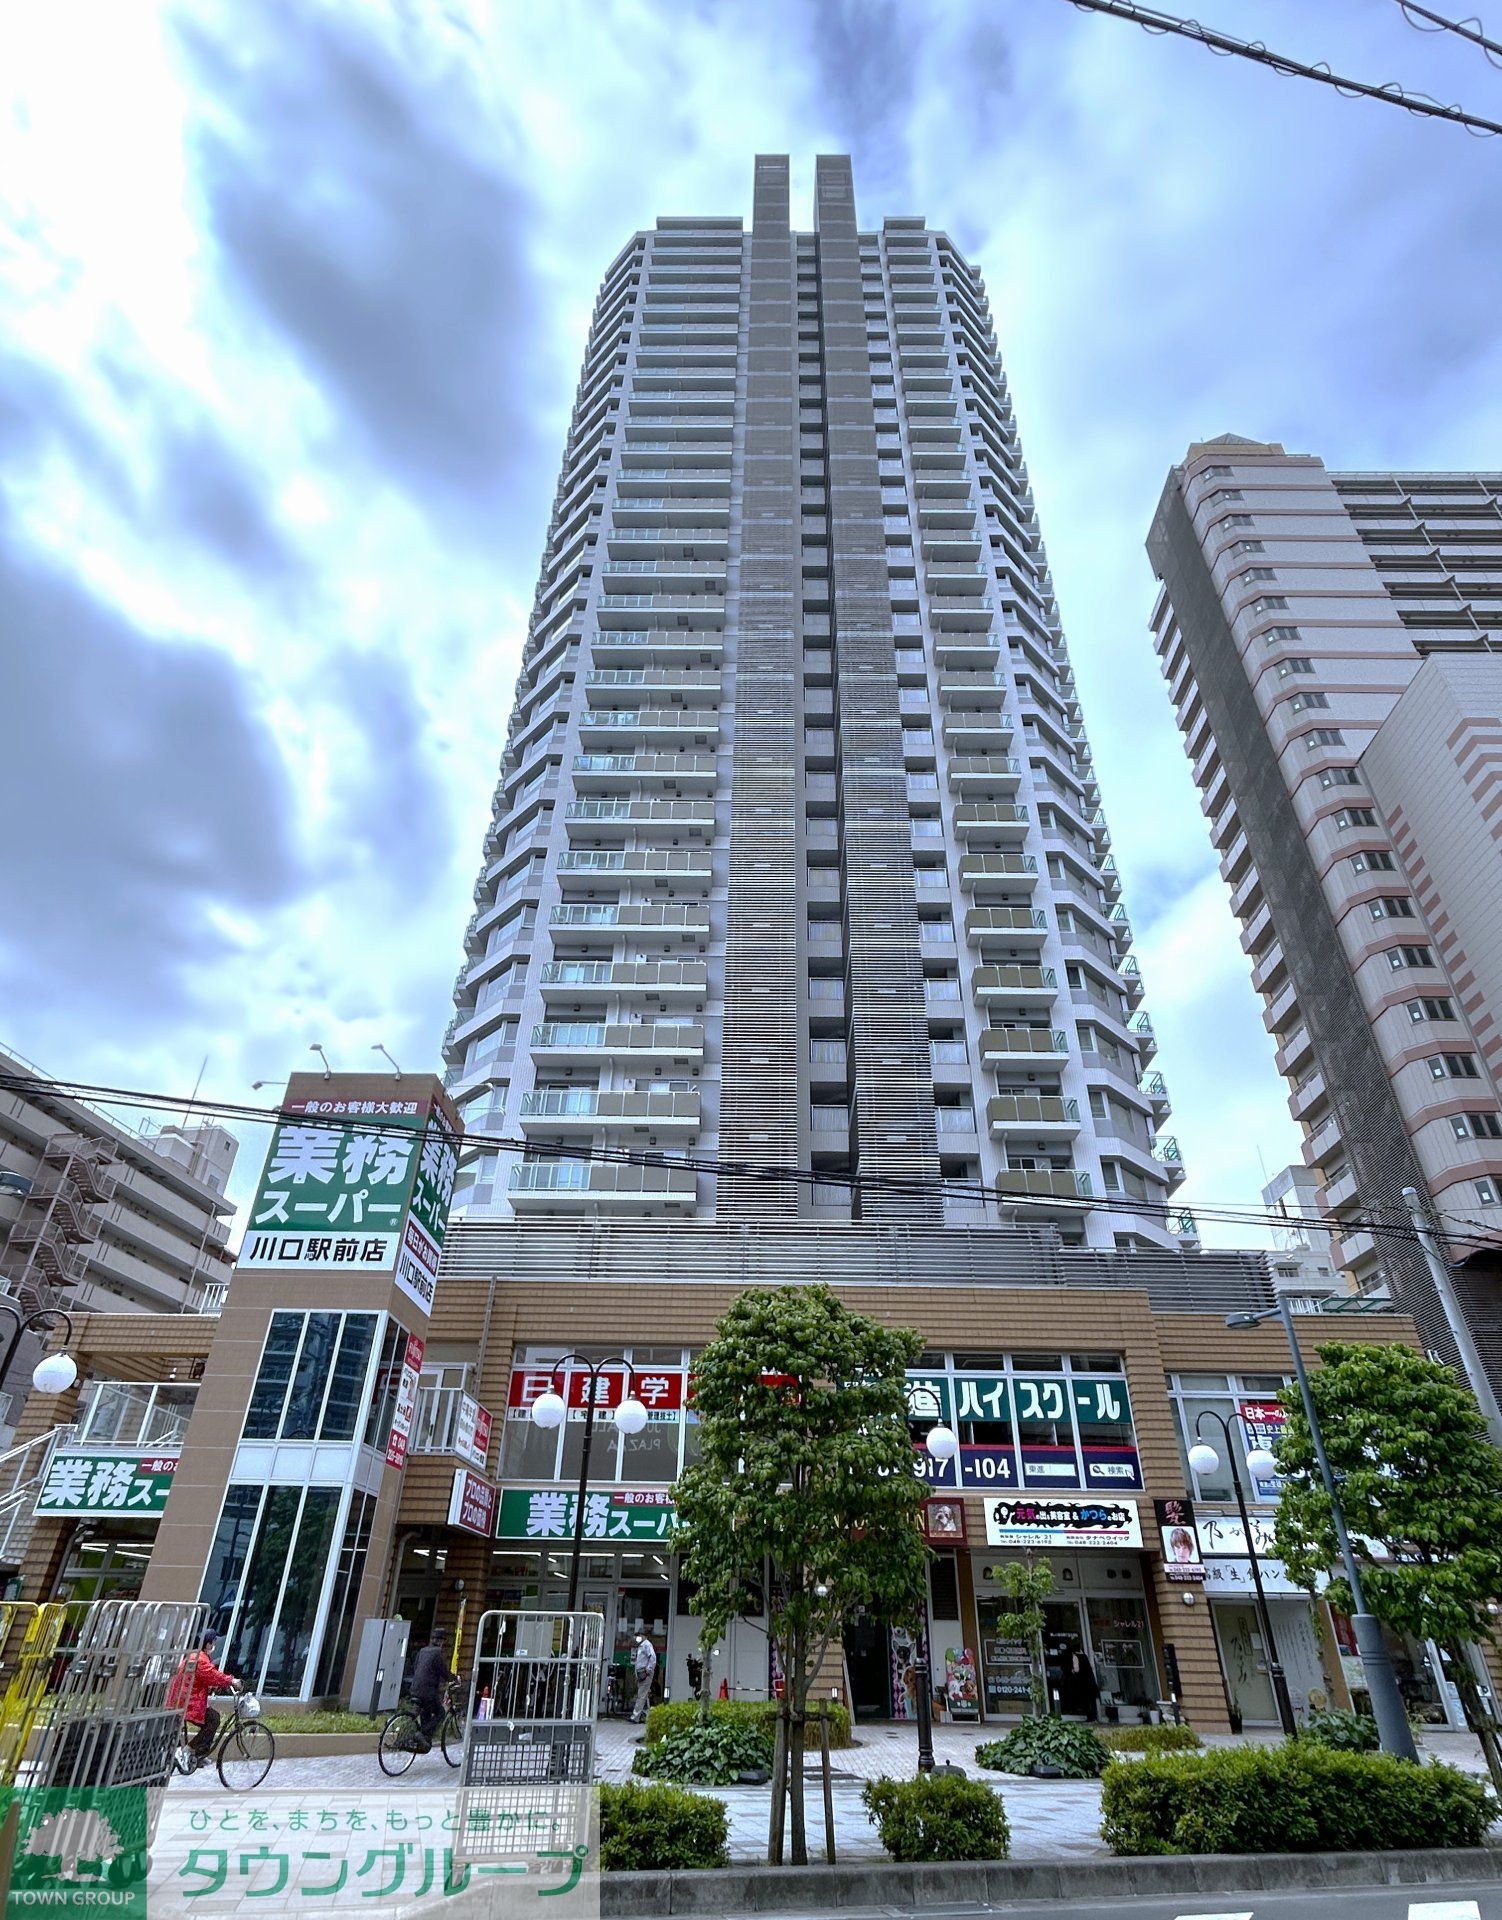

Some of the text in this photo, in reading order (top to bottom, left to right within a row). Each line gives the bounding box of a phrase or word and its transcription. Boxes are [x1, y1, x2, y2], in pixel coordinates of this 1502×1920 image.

[291, 1100, 419, 1115] 一般のお客様大歓迎
[267, 1120, 415, 1184] 業務
[255, 1188, 402, 1224] スーパー
[249, 1236, 388, 1262] 川口駅前店
[399, 1251, 434, 1304] 川口駅前店
[526, 1491, 691, 1537] 業務スーパ
